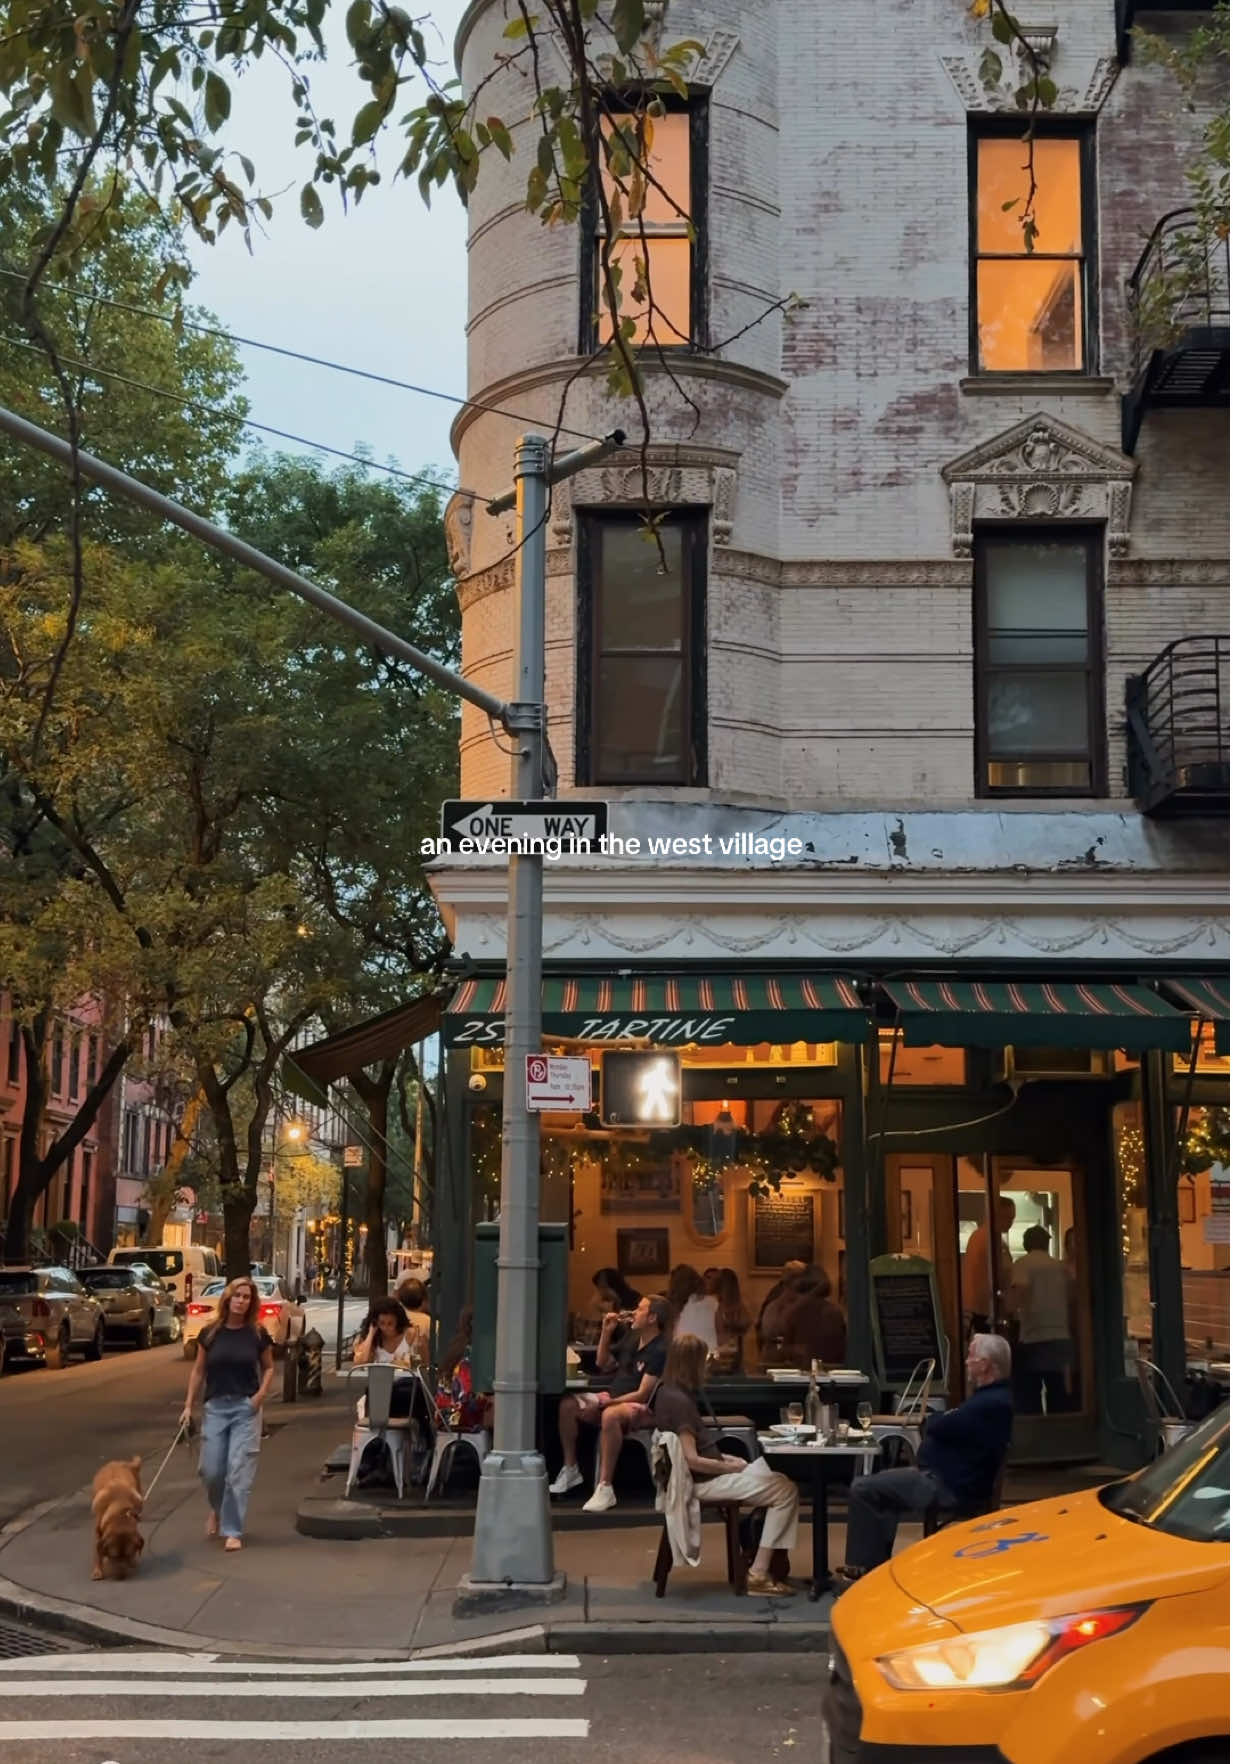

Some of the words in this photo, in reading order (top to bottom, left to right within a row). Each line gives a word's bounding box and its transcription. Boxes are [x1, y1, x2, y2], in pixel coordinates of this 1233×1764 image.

[469, 817, 513, 837] ONE
[544, 817, 589, 837] WAY
[577, 1017, 735, 1040] TARTINE
